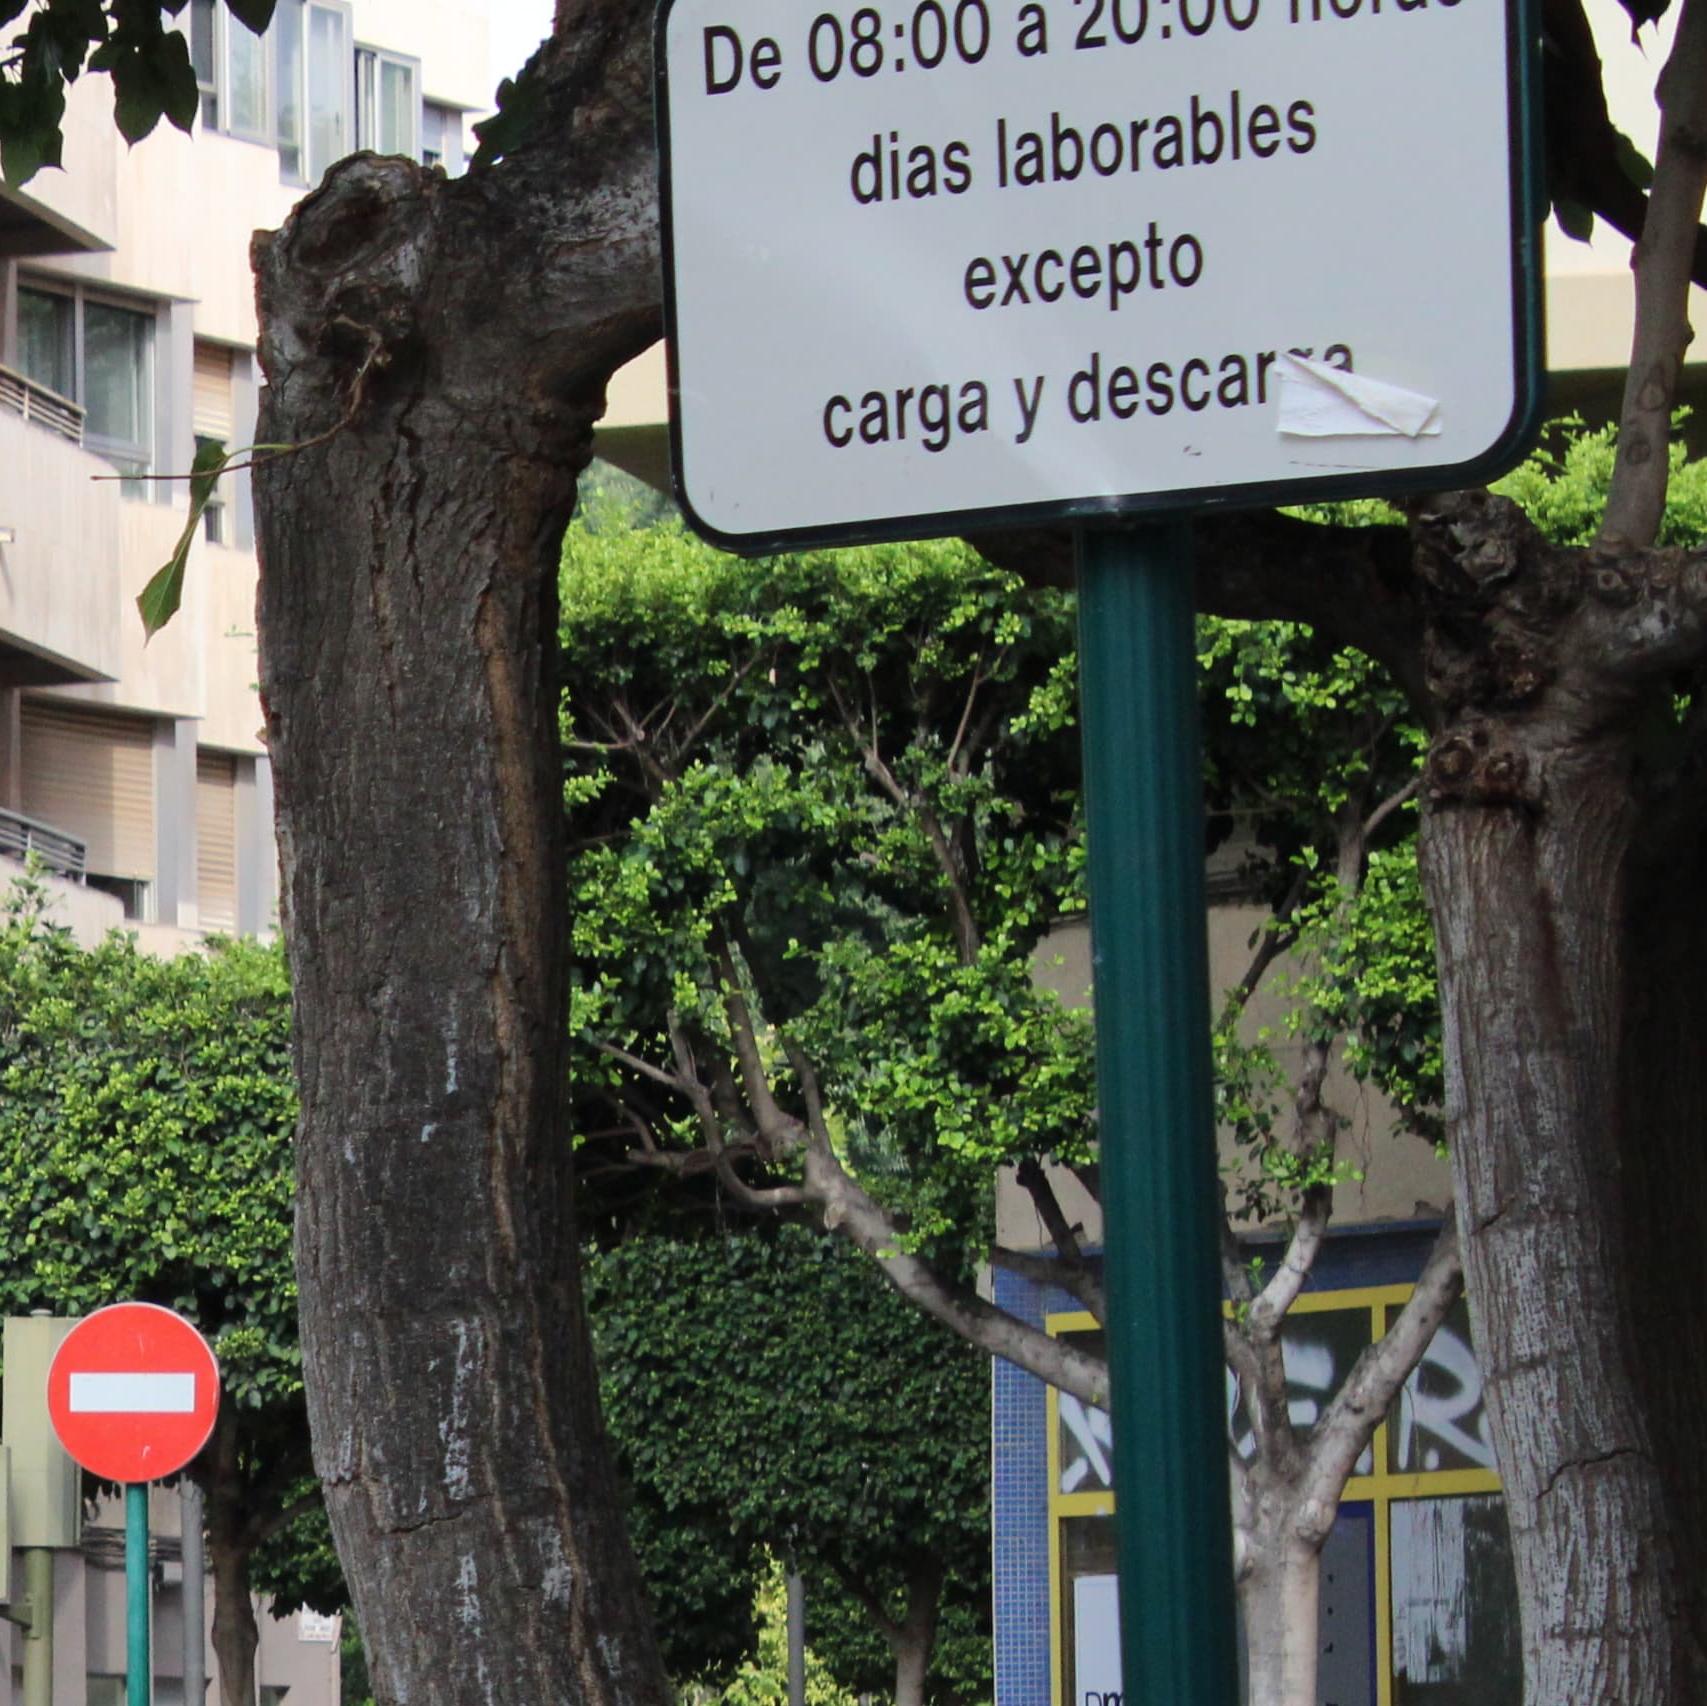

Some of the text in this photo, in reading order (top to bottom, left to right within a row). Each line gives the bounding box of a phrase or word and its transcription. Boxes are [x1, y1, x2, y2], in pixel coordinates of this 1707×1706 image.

[703, 24, 782, 95] De
[808, 0, 991, 83] 08:00
[1017, 3, 1048, 57] a
[851, 90, 1317, 204] dias laborables
[965, 222, 1204, 310] excepto
[823, 377, 988, 453] carga
[1013, 375, 1045, 443] y
